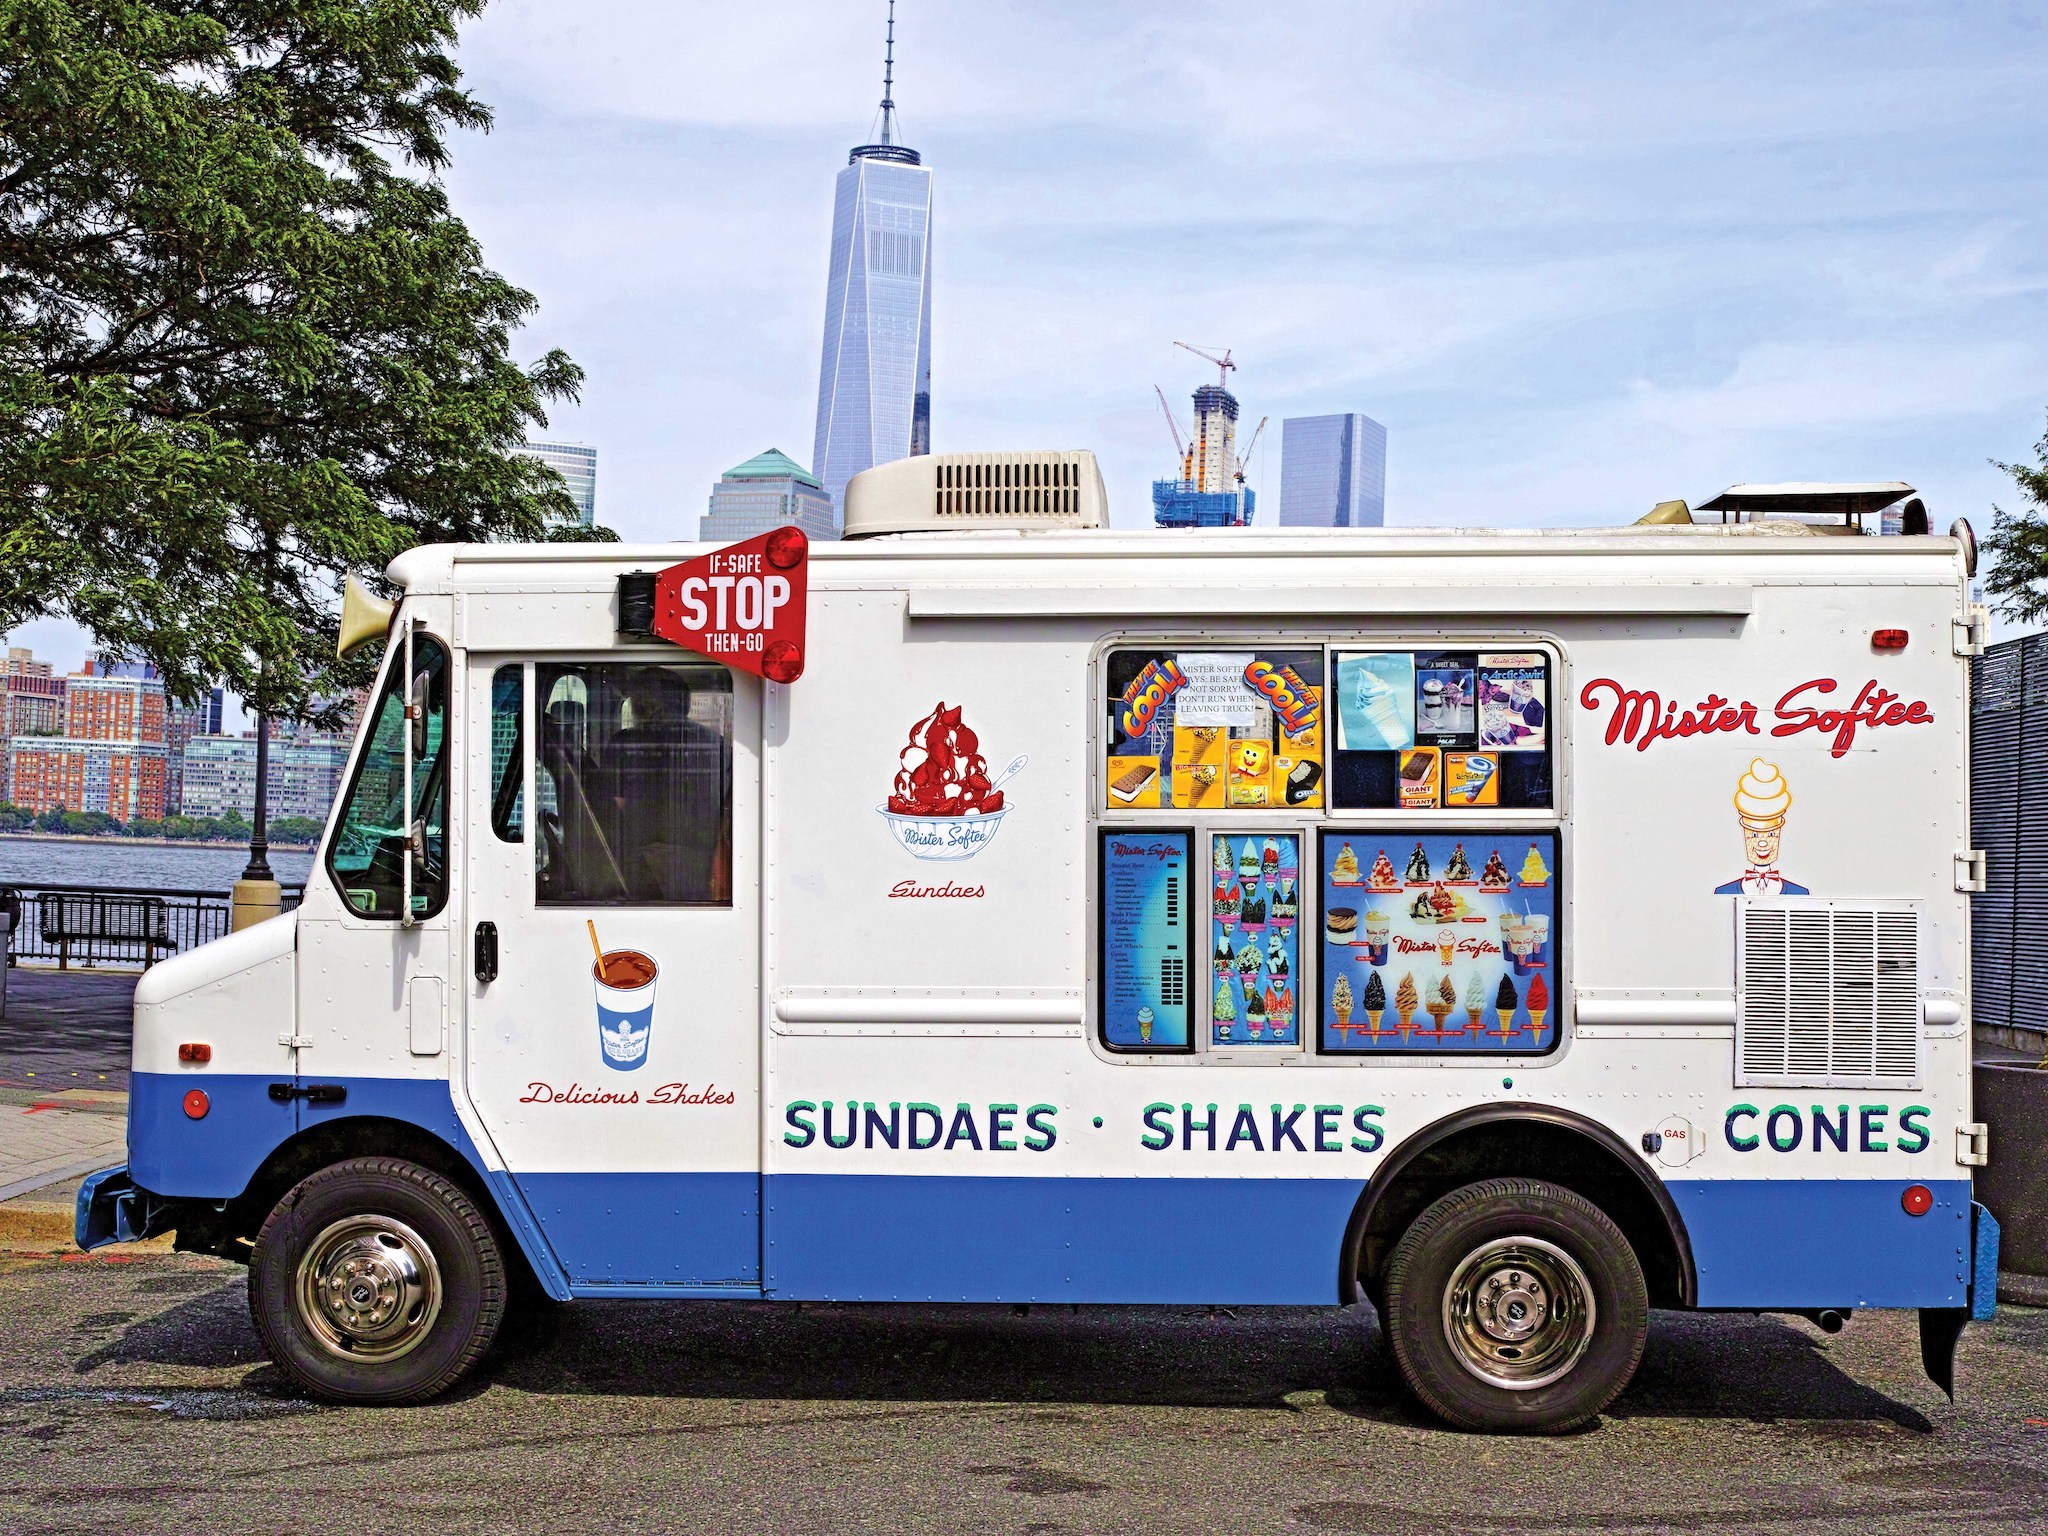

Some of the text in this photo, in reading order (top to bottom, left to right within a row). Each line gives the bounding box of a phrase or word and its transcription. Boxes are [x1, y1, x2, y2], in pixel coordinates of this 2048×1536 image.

[709, 554, 761, 574] IF-SAFE
[680, 575, 791, 631] STOP
[705, 633, 764, 652] THEN-GO
[1123, 661, 1158, 704] THEY'RE
[1279, 666, 1318, 706] THEY'RE
[1488, 669, 1544, 680] Arctic Swirl
[1123, 659, 1187, 737] COOL!
[1245, 661, 1316, 732] COOL!
[1580, 678, 1934, 759] Mister Softee
[904, 826, 986, 849] Mister Softee
[1111, 841, 1183, 860] Mister Softee
[888, 880, 985, 898] Sundaes
[1392, 935, 1501, 959] Mister Softee
[519, 1082, 735, 1105] Delicious Shakes
[783, 1100, 1058, 1152] SUNDAES
[1140, 1102, 1386, 1153] SHAKES
[1664, 1129, 1686, 1139] GAS
[1724, 1103, 1931, 1154] CONES
